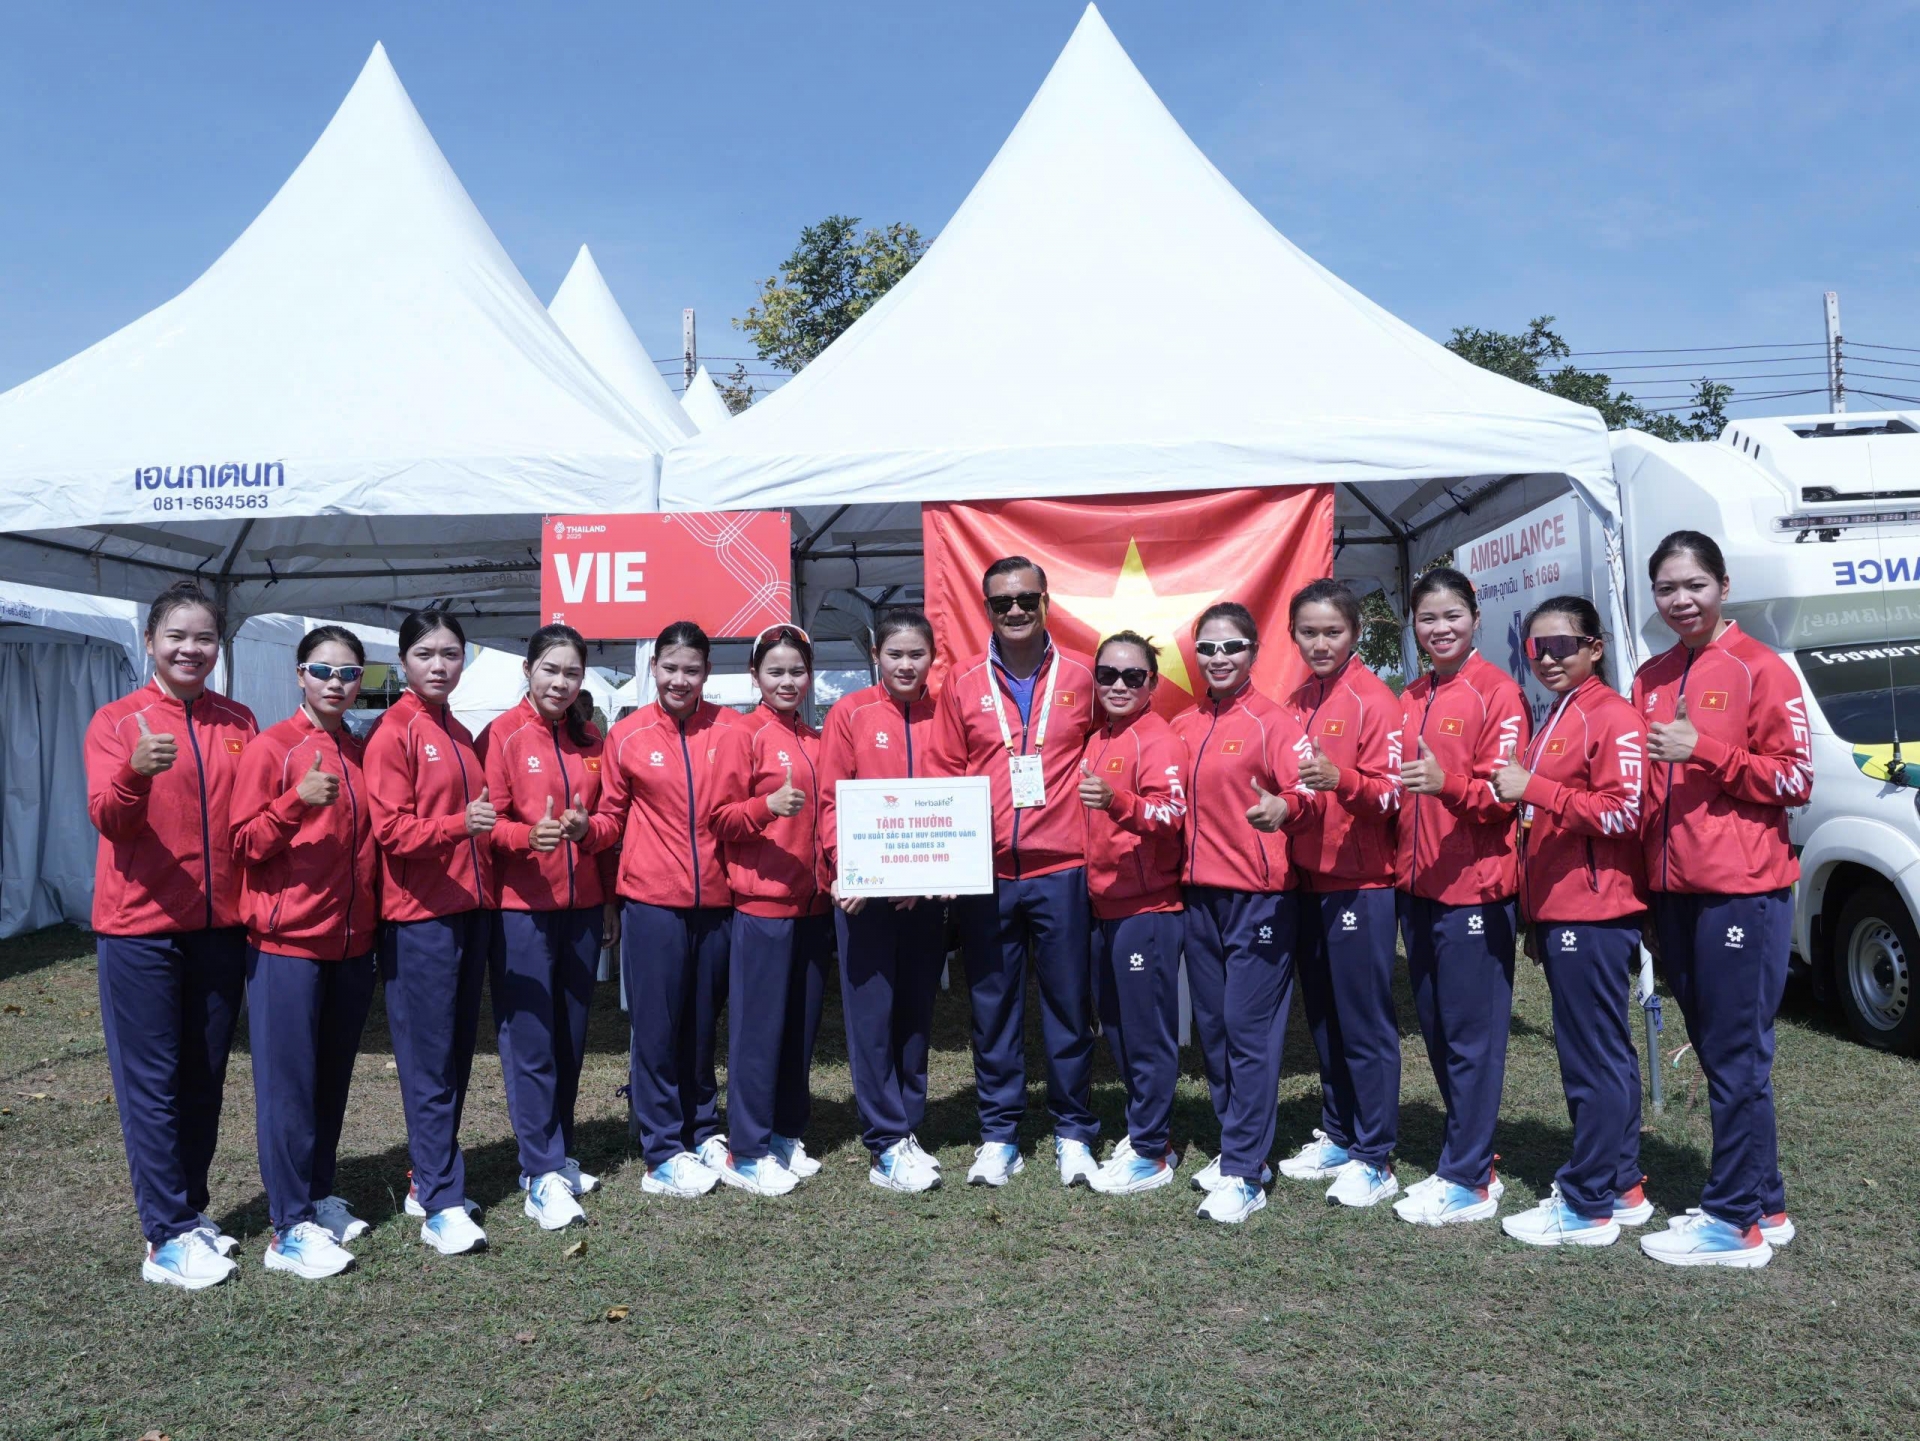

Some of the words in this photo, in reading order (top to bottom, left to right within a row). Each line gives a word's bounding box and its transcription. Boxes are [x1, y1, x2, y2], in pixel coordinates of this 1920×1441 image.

[153, 495, 268, 511] 081-6634563
[1470, 514, 1566, 574] AMBULANCE
[553, 551, 647, 603] VIE
[914, 799, 951, 807] Herbalife
[911, 841, 935, 849] GAMES
[880, 854, 930, 863] 10.000.000
